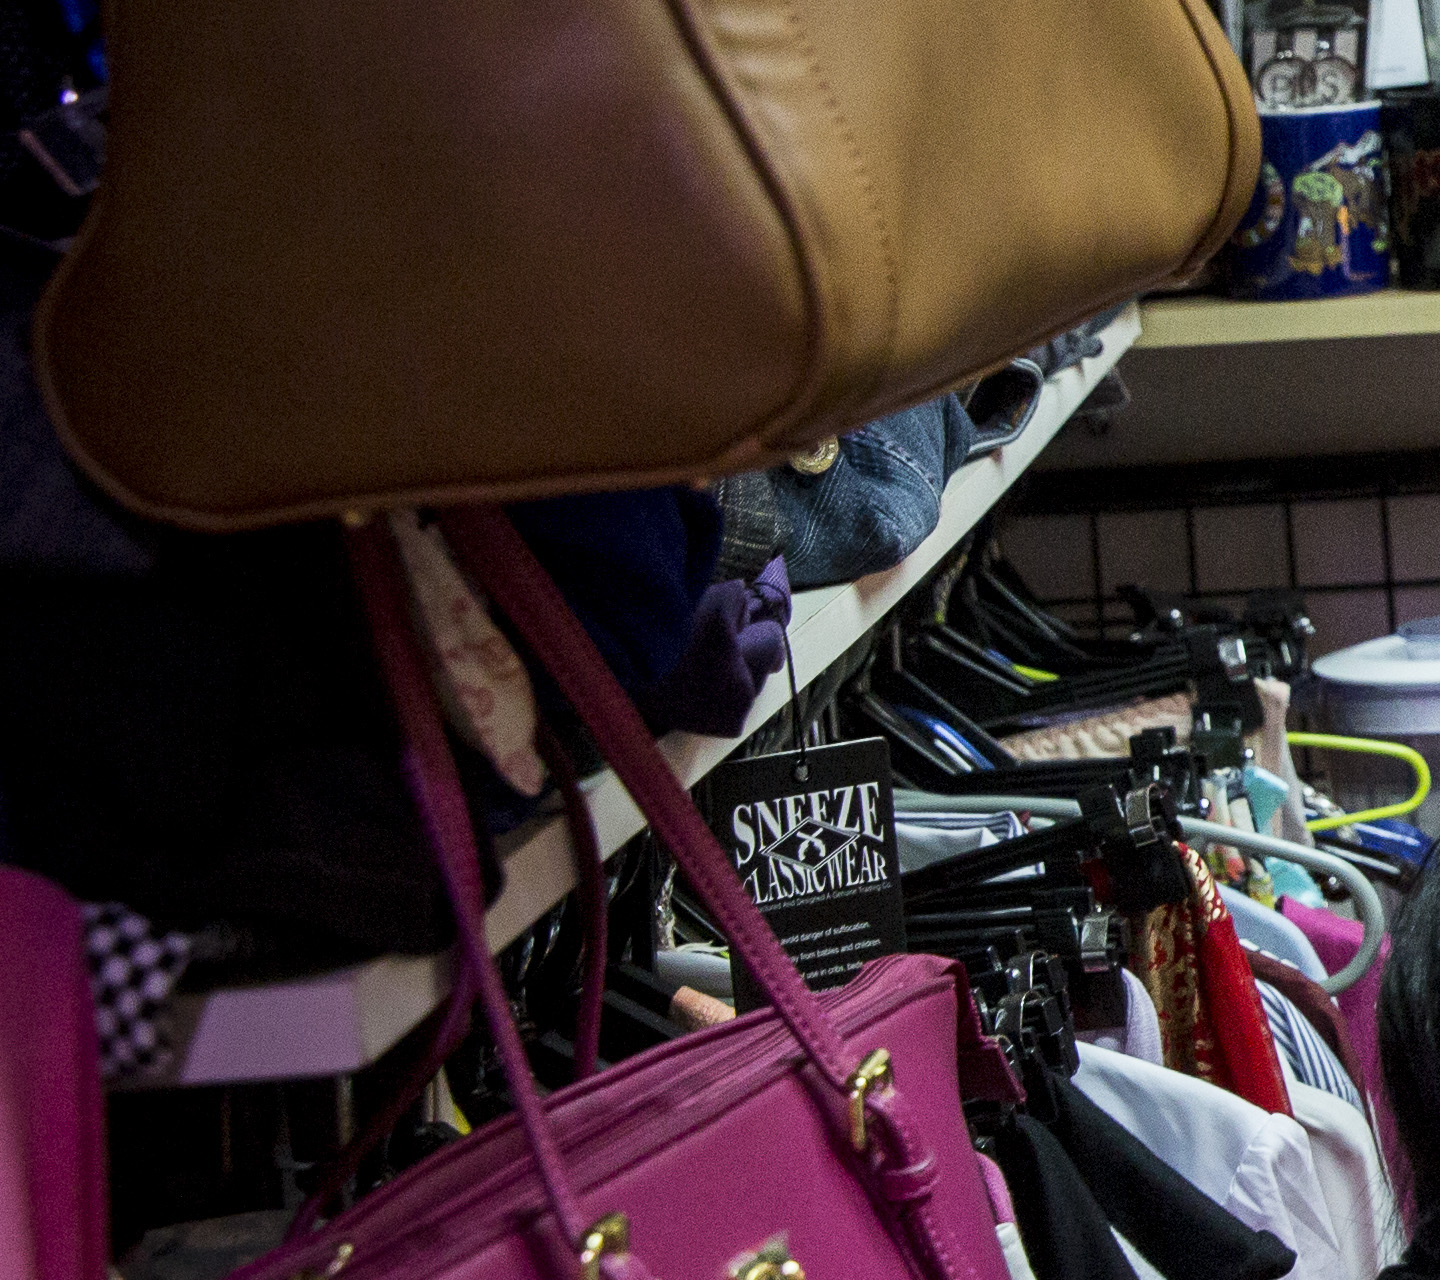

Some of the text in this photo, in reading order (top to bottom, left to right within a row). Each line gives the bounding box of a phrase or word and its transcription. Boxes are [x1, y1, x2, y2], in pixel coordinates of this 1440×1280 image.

[733, 781, 884, 869] SNEEZE
[800, 929, 824, 942] danger
[800, 951, 816, 962] from
[817, 946, 839, 959] babies
[840, 942, 854, 953] and
